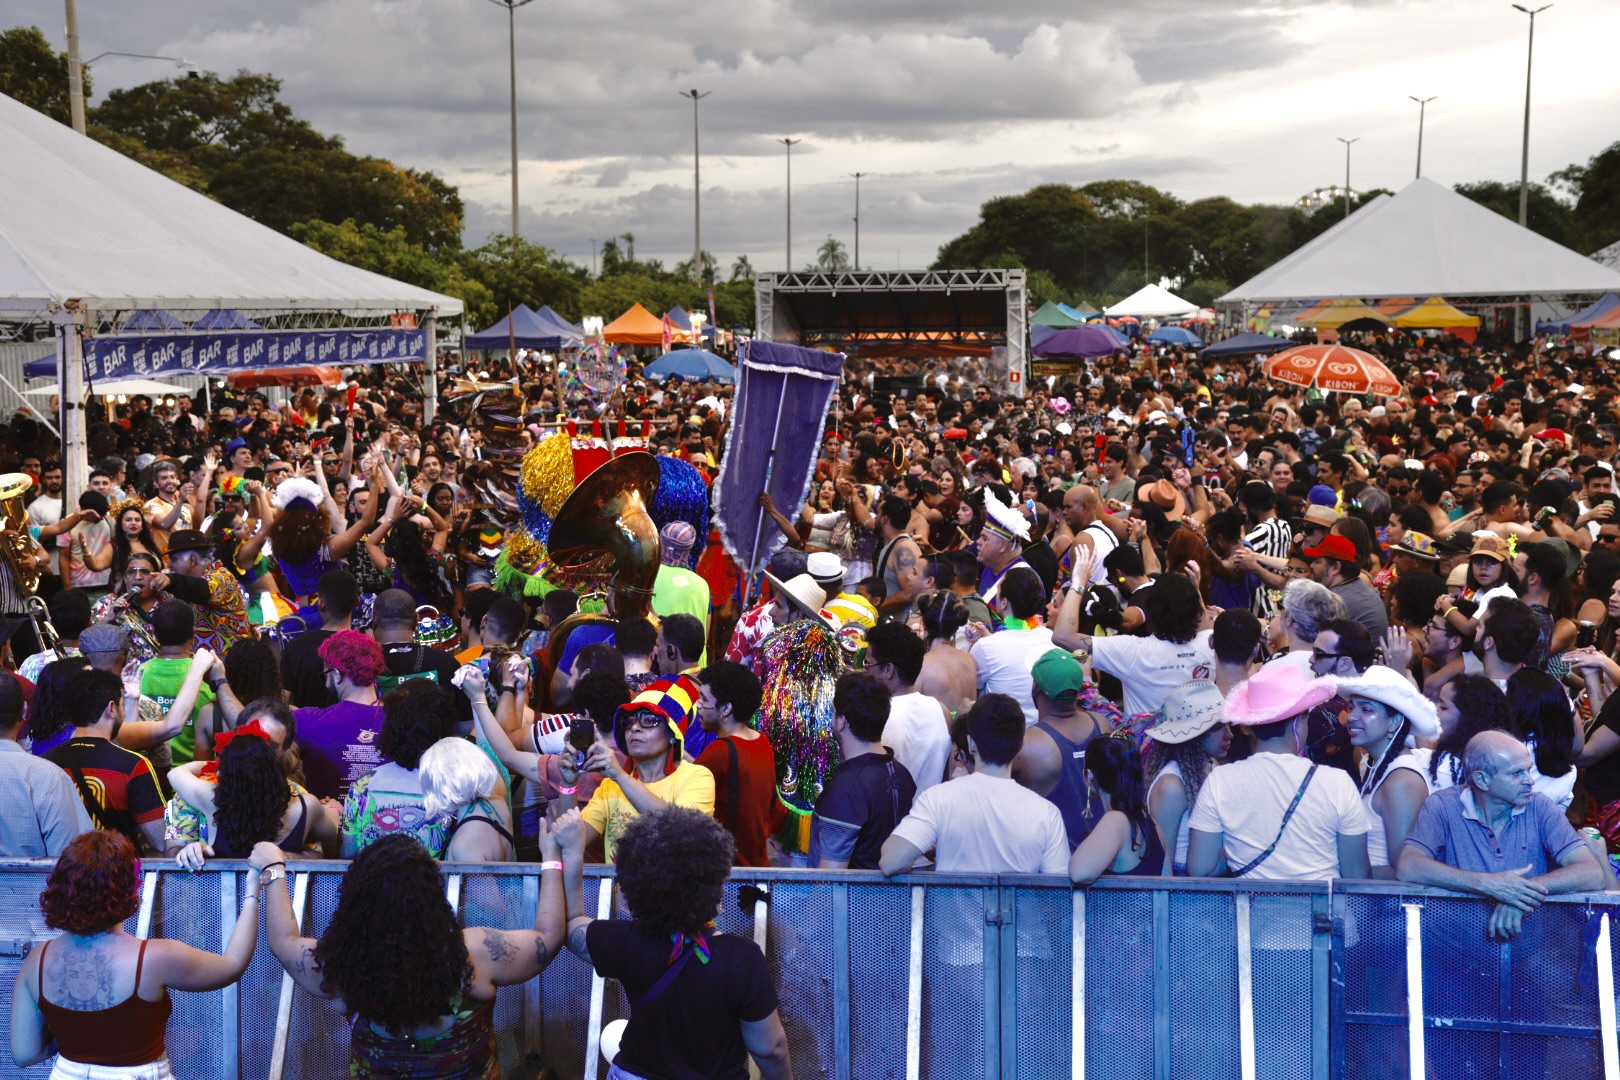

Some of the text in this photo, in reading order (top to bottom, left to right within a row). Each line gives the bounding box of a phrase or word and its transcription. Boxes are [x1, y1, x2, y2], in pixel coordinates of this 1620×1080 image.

[104, 345, 126, 375] BAR
[152, 342, 175, 370] BAR
[200, 340, 221, 367] BAR
[244, 338, 263, 364] BAR
[285, 337, 301, 362] BAR
[319, 337, 335, 360] BAR
[352, 336, 367, 358] BAR
[381, 335, 396, 357] BAR
[410, 334, 423, 355] BAR
[1279, 370, 1304, 382] KIBON
[1325, 380, 1357, 390] KIBON
